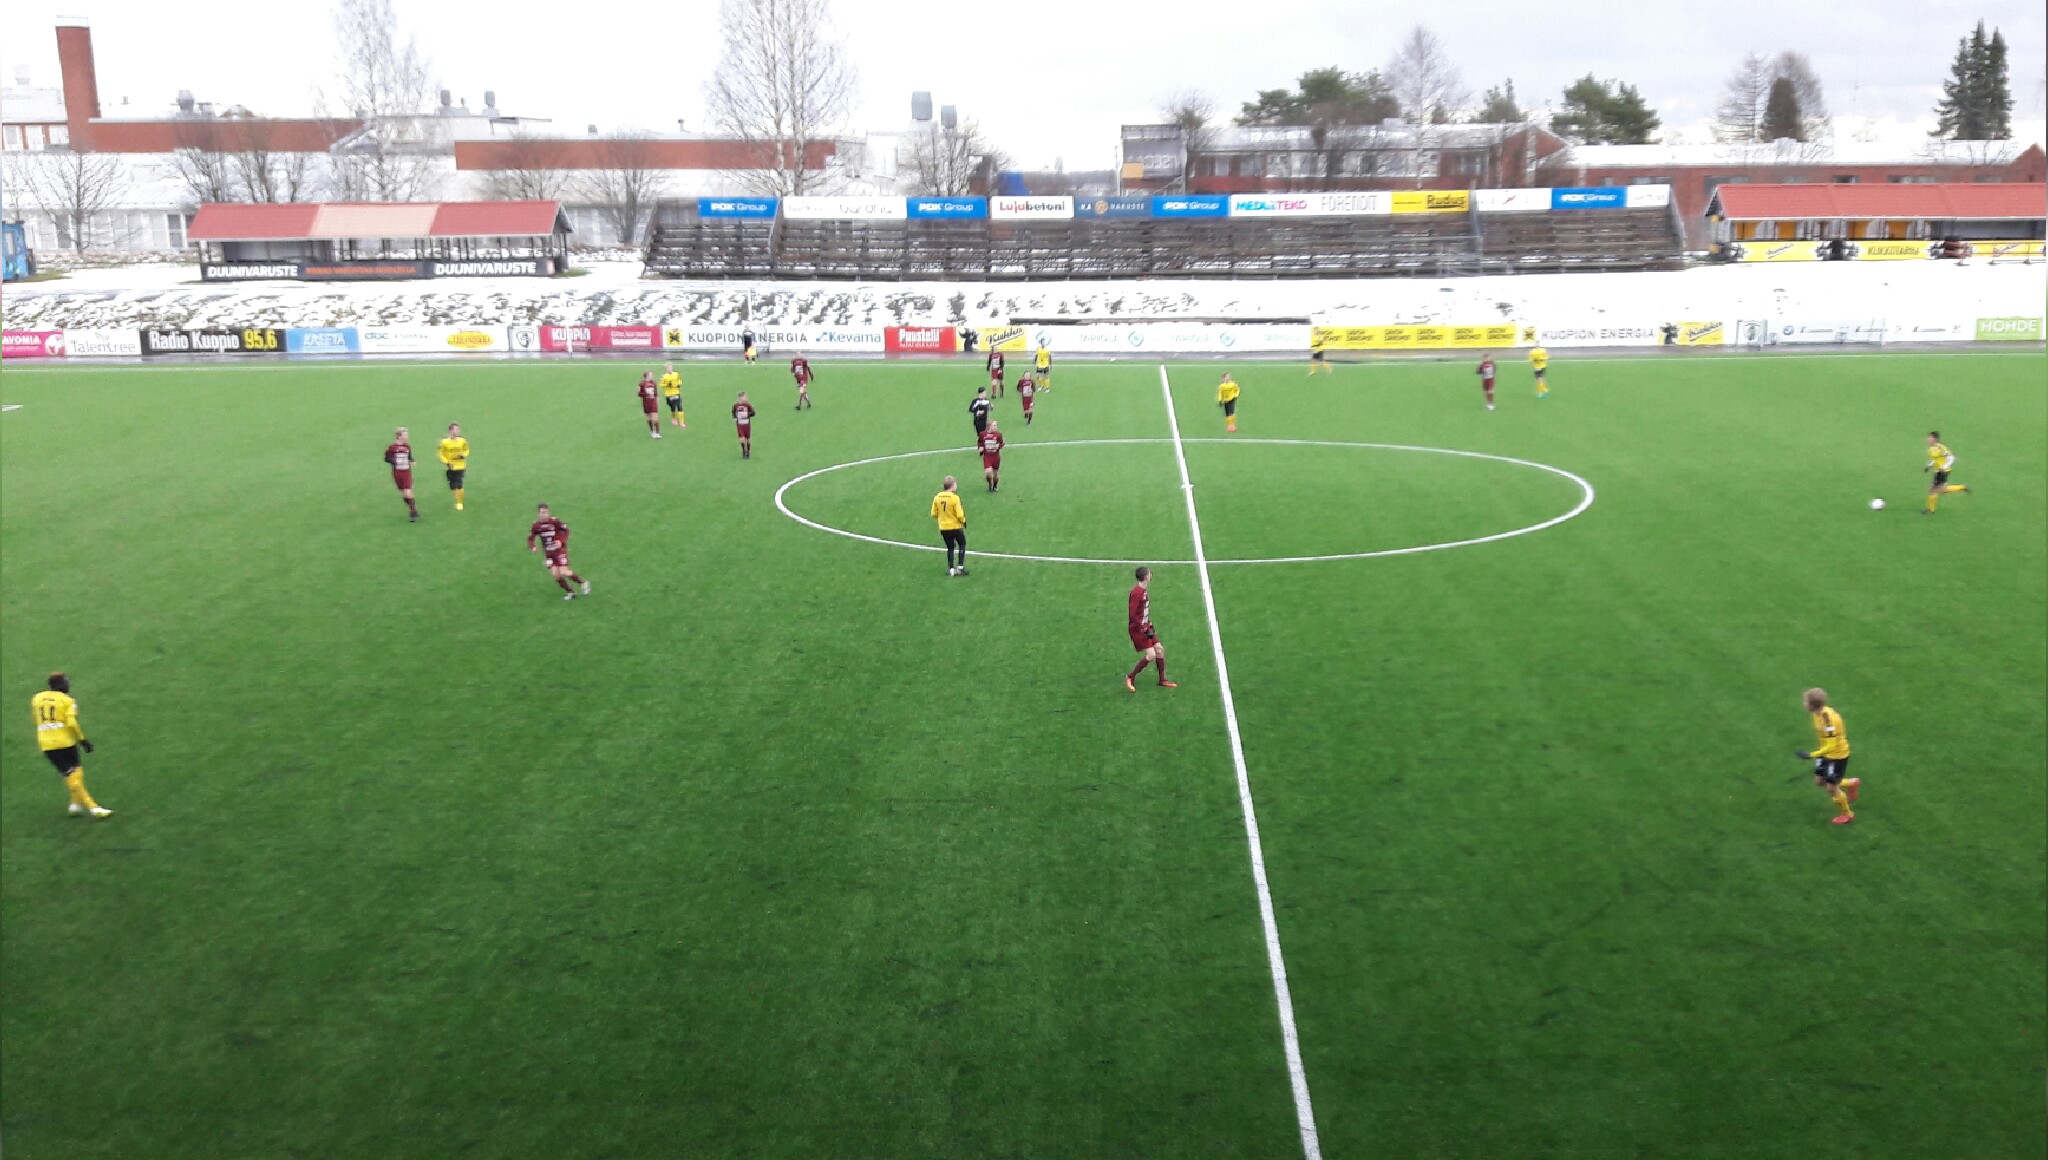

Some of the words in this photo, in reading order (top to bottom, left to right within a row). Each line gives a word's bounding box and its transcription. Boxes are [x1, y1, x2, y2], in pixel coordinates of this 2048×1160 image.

[1000, 201, 1065, 215] Lujabetoni
[207, 265, 298, 277] DUUNIVARUSTE
[433, 261, 537, 275] DUUNIVARUSTE
[1980, 320, 2037, 332] HOHDE
[829, 331, 881, 343] Kevama
[1541, 328, 1596, 340] KUOPION
[1600, 327, 1654, 339] ENERGIA
[71, 340, 136, 353] Talentree
[151, 331, 188, 349] Radio
[193, 331, 240, 353] Kuopio
[940, 500, 947, 512] 7
[39, 704, 56, 722] 11
